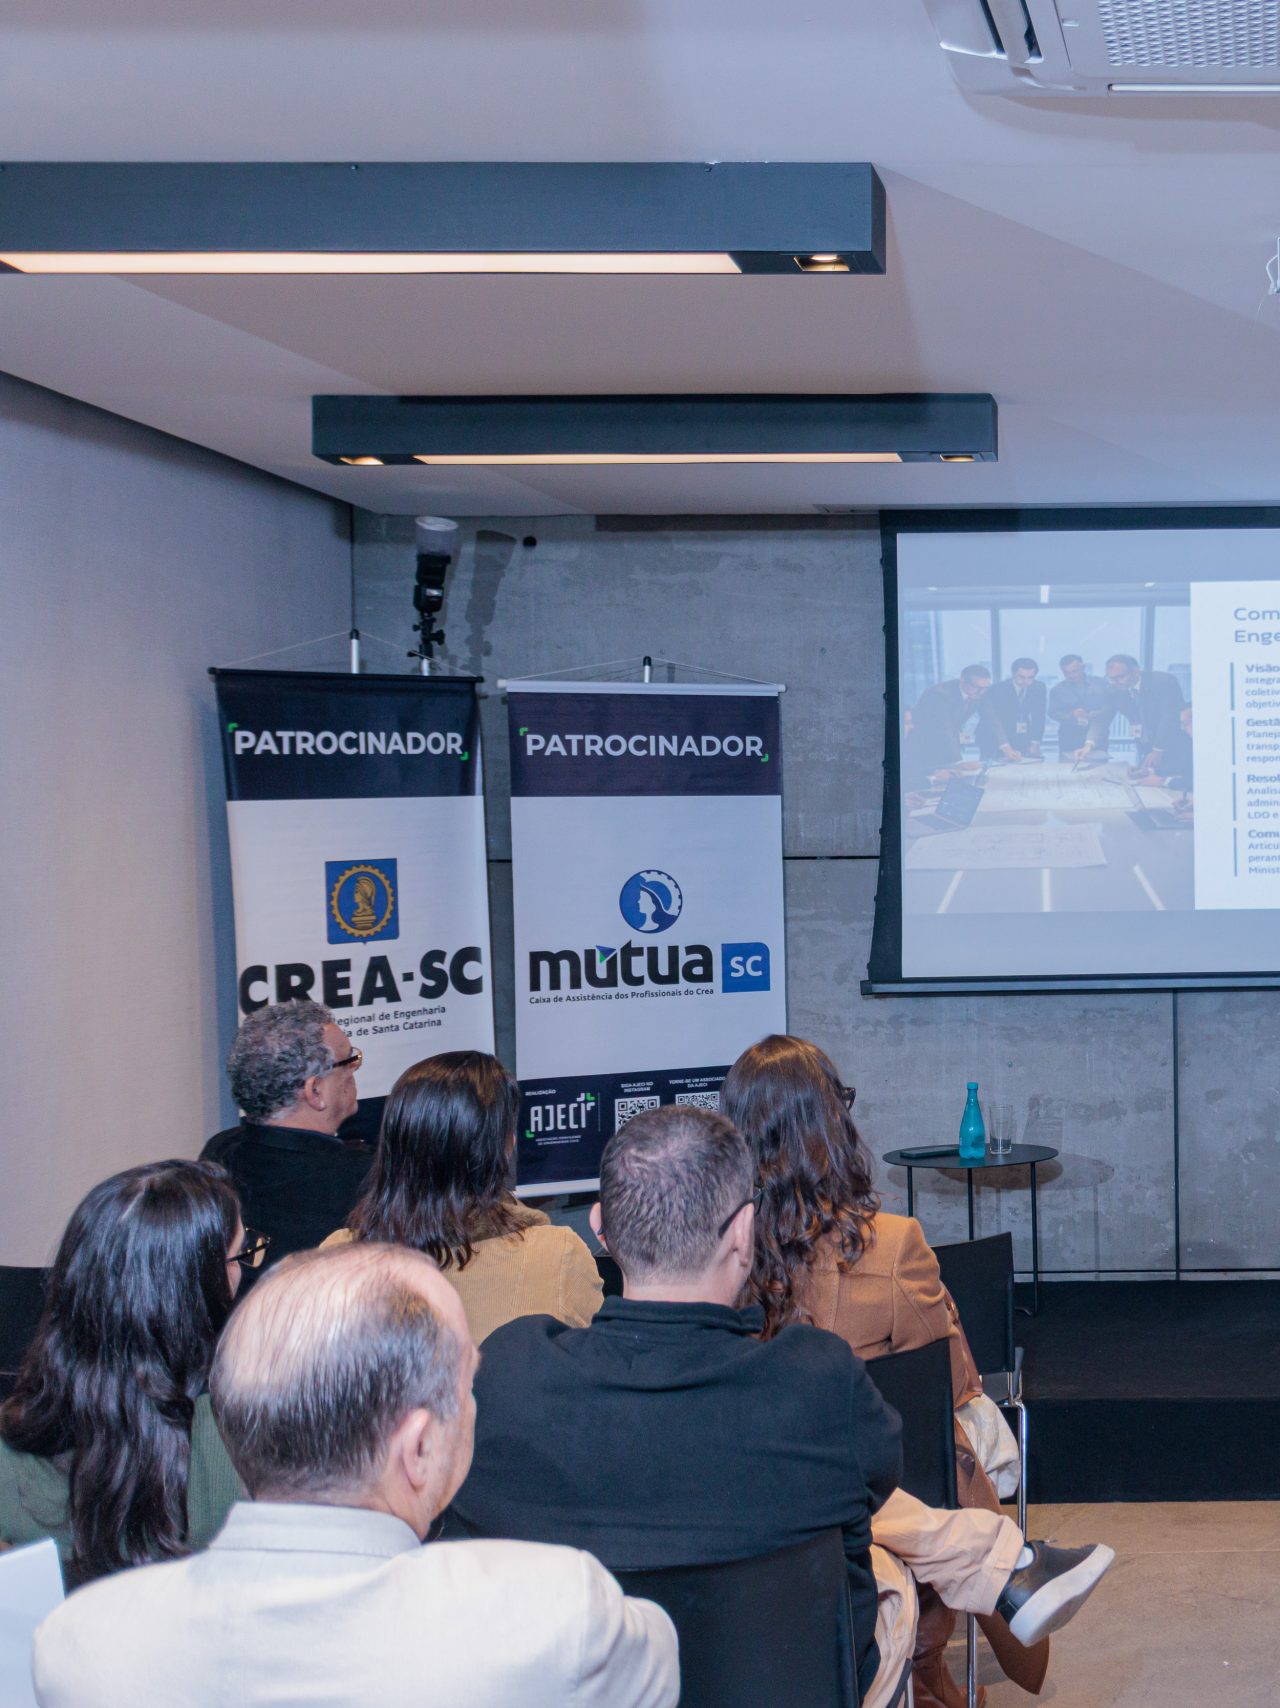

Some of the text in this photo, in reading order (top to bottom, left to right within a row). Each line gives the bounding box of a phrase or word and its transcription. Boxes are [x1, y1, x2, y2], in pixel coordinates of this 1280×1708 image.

[1246, 662, 1280, 673] Visão
[234, 730, 463, 755] PATROCINADOR
[526, 734, 763, 757] PATROCINADOR
[1248, 810, 1270, 819] LDO
[730, 955, 763, 978] SC
[240, 946, 483, 1015] CREA-SC
[529, 987, 714, 1004] Caixa de Assistência dos Profissionais do Crea
[334, 1005, 446, 1027] egional de Engenharia
[356, 1027, 369, 1036] de
[372, 1023, 400, 1035] Santa
[402, 1018, 442, 1031] Catarina
